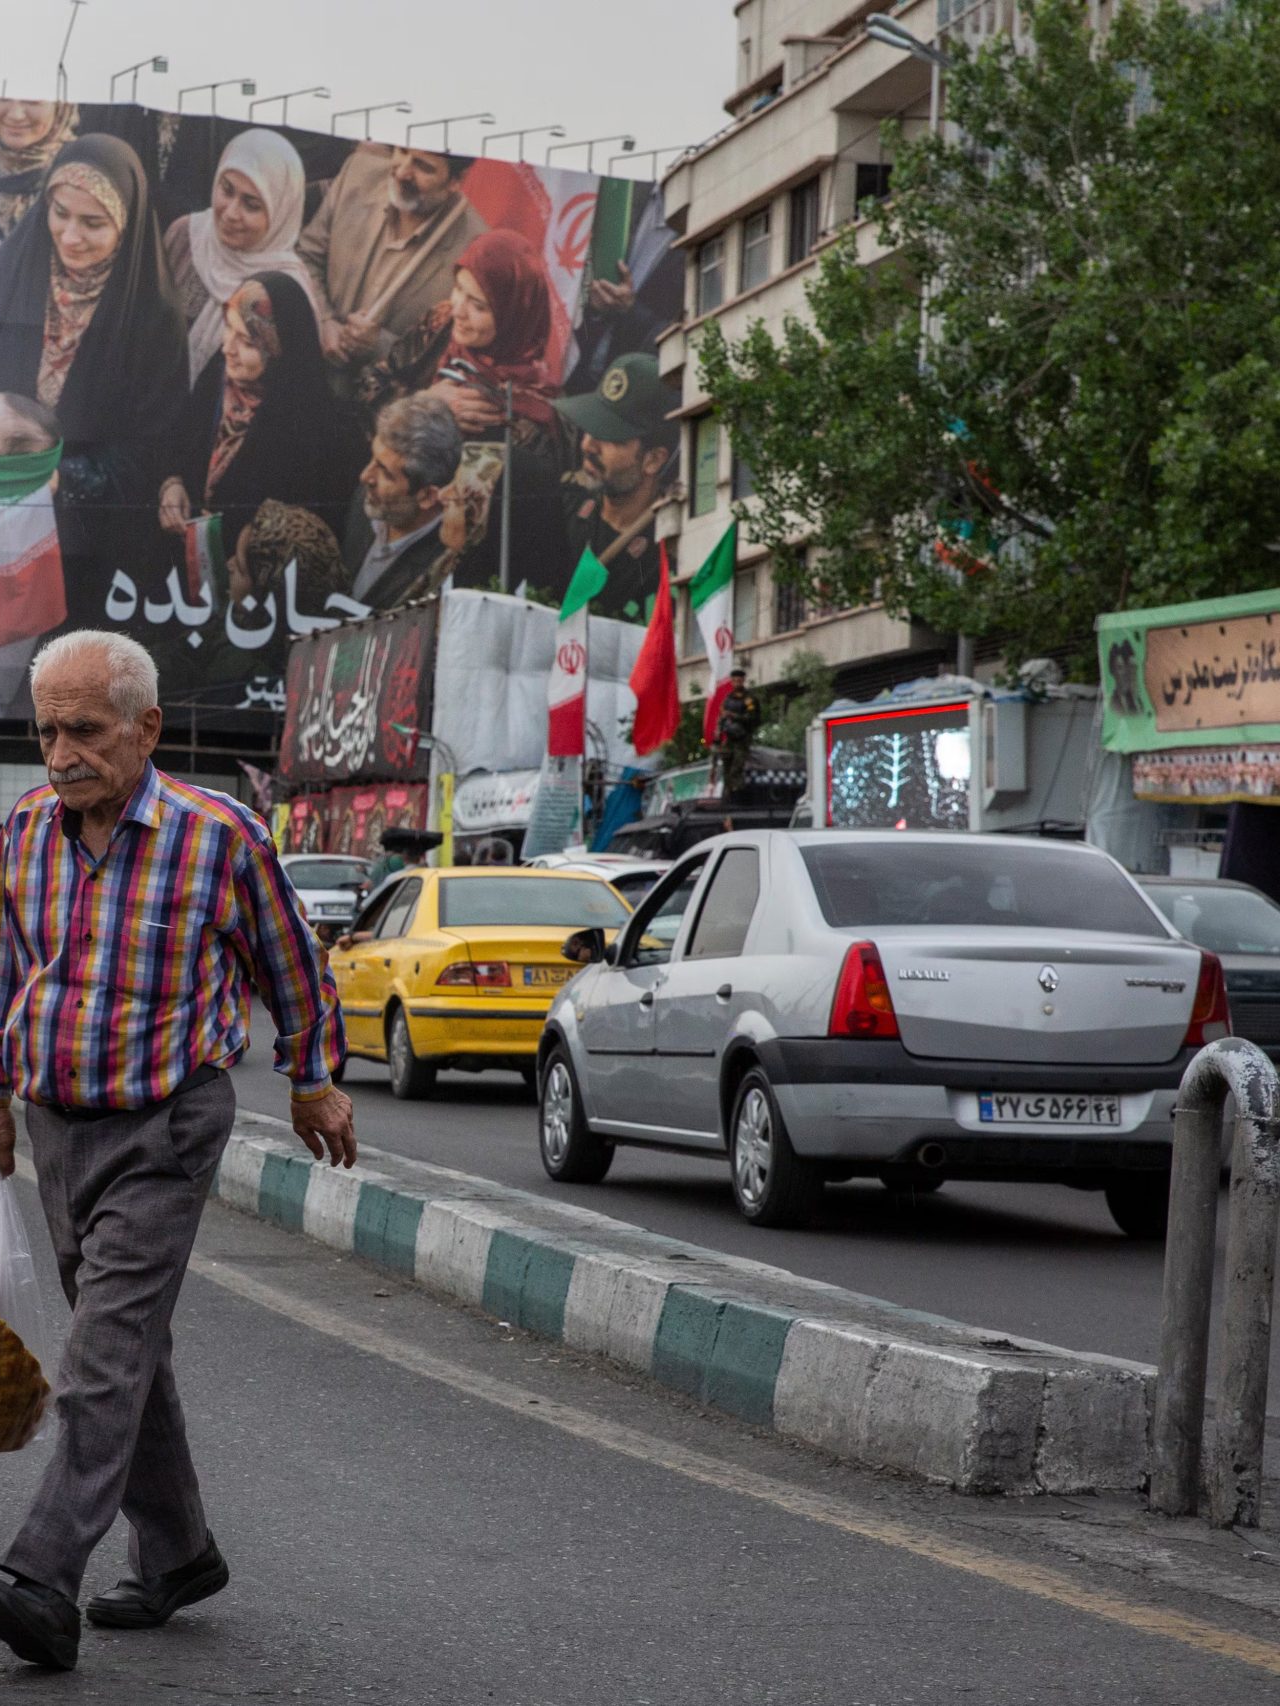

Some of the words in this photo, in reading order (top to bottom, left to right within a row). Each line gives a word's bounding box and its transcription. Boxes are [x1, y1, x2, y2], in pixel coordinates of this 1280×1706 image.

[105, 564, 213, 649] بده
[235, 676, 287, 711] هتر
[898, 968, 951, 982] RENAULT
[1093, 1102, 1118, 1122] ۴۴
